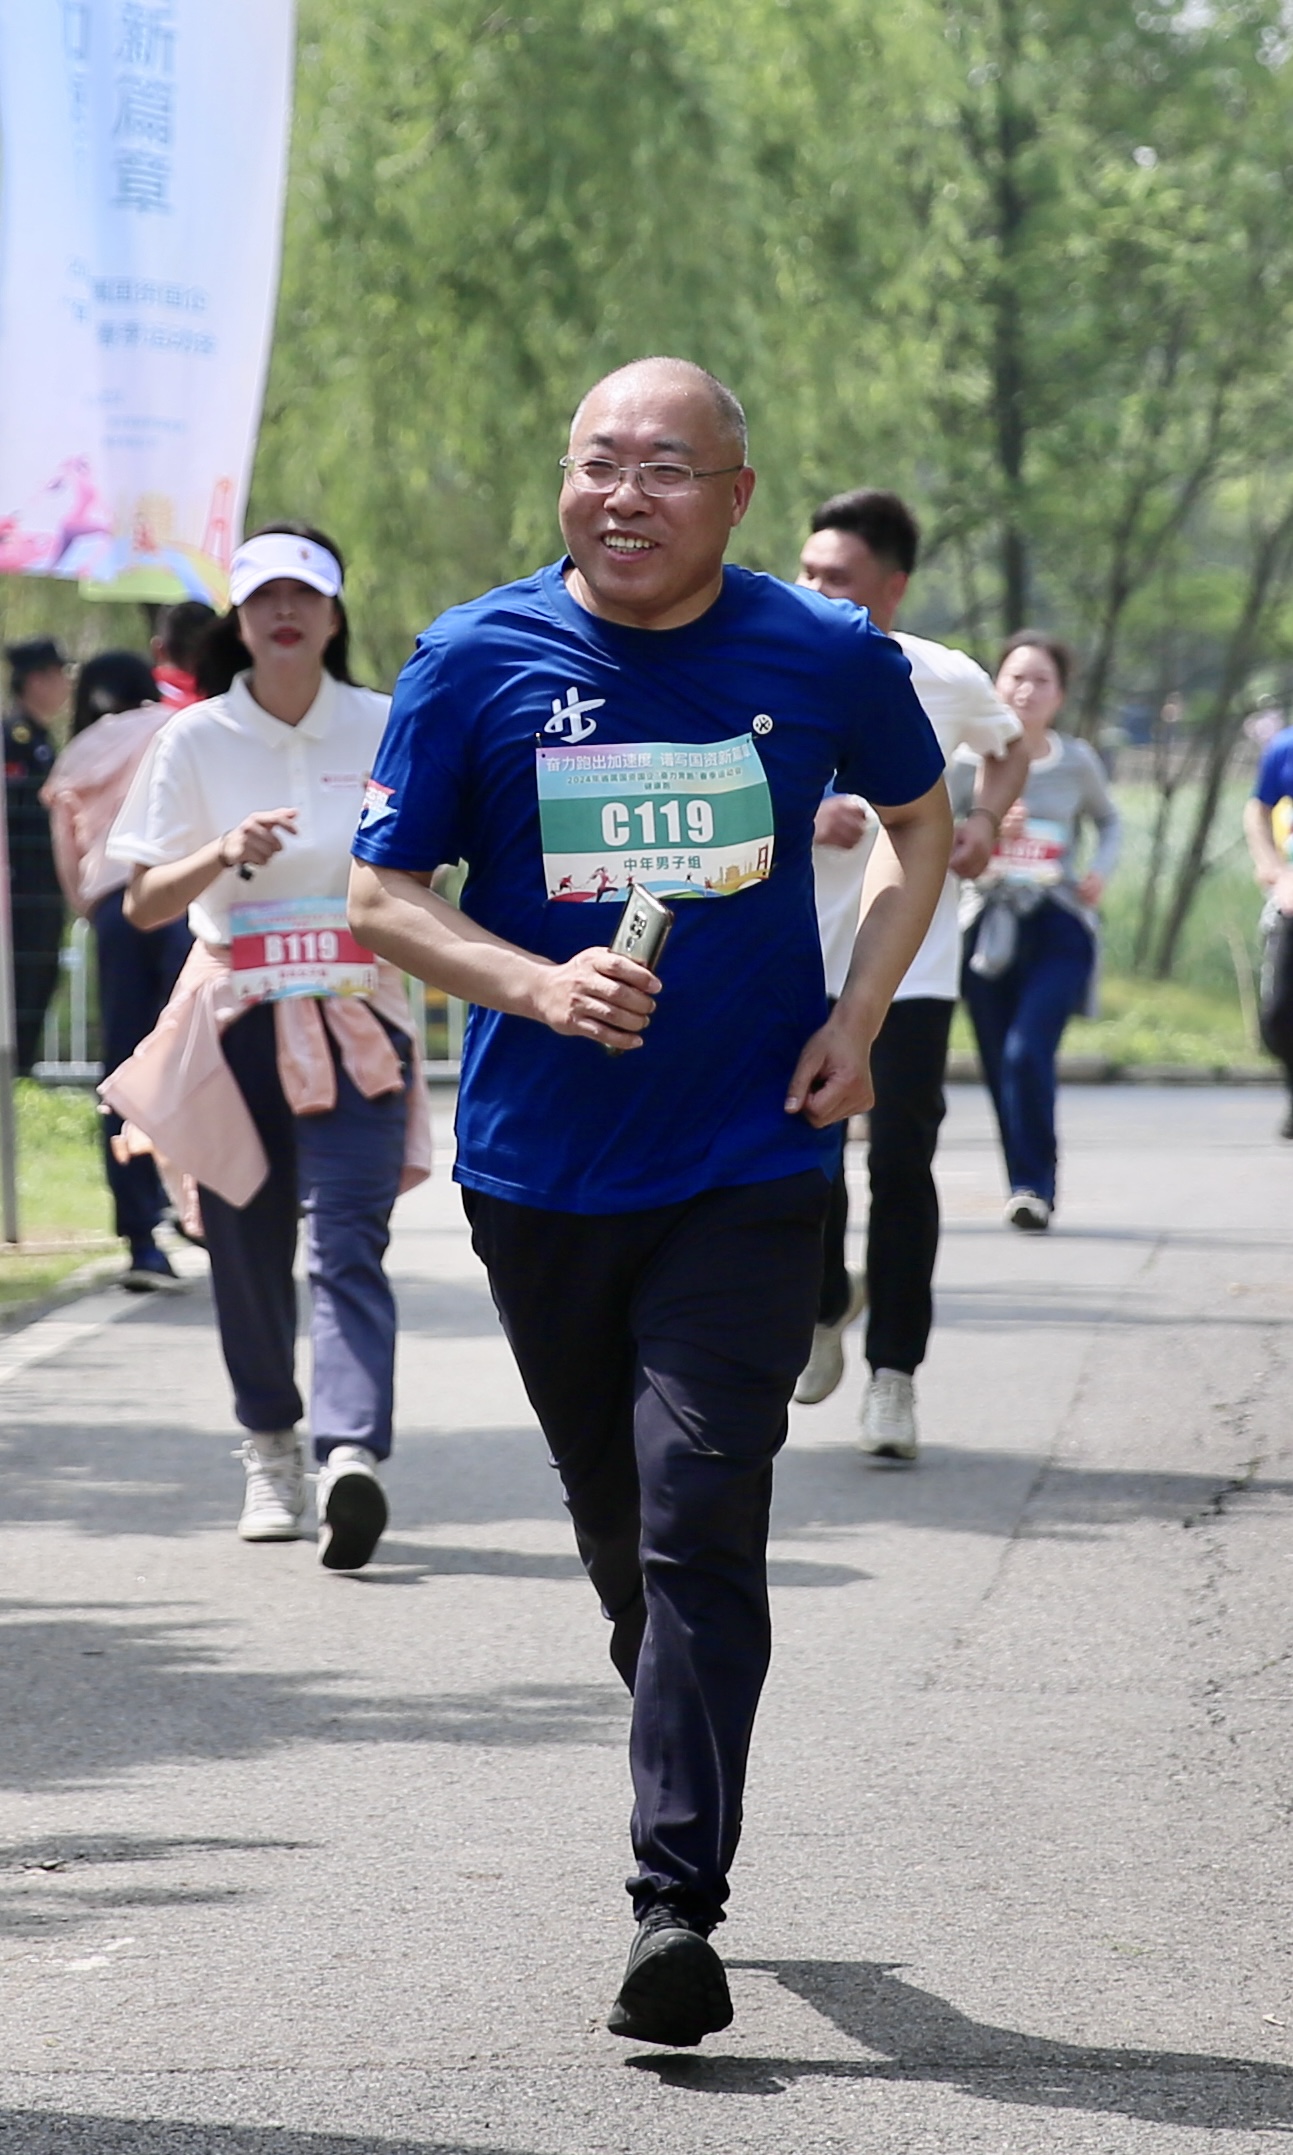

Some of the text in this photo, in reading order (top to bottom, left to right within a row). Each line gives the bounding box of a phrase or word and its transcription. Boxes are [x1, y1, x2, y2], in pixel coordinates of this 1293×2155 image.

[546, 752, 653, 772] 奋力跑出加速度
[601, 800, 715, 847] C119
[623, 856, 702, 871] 中年男子组
[264, 930, 339, 965] B119
